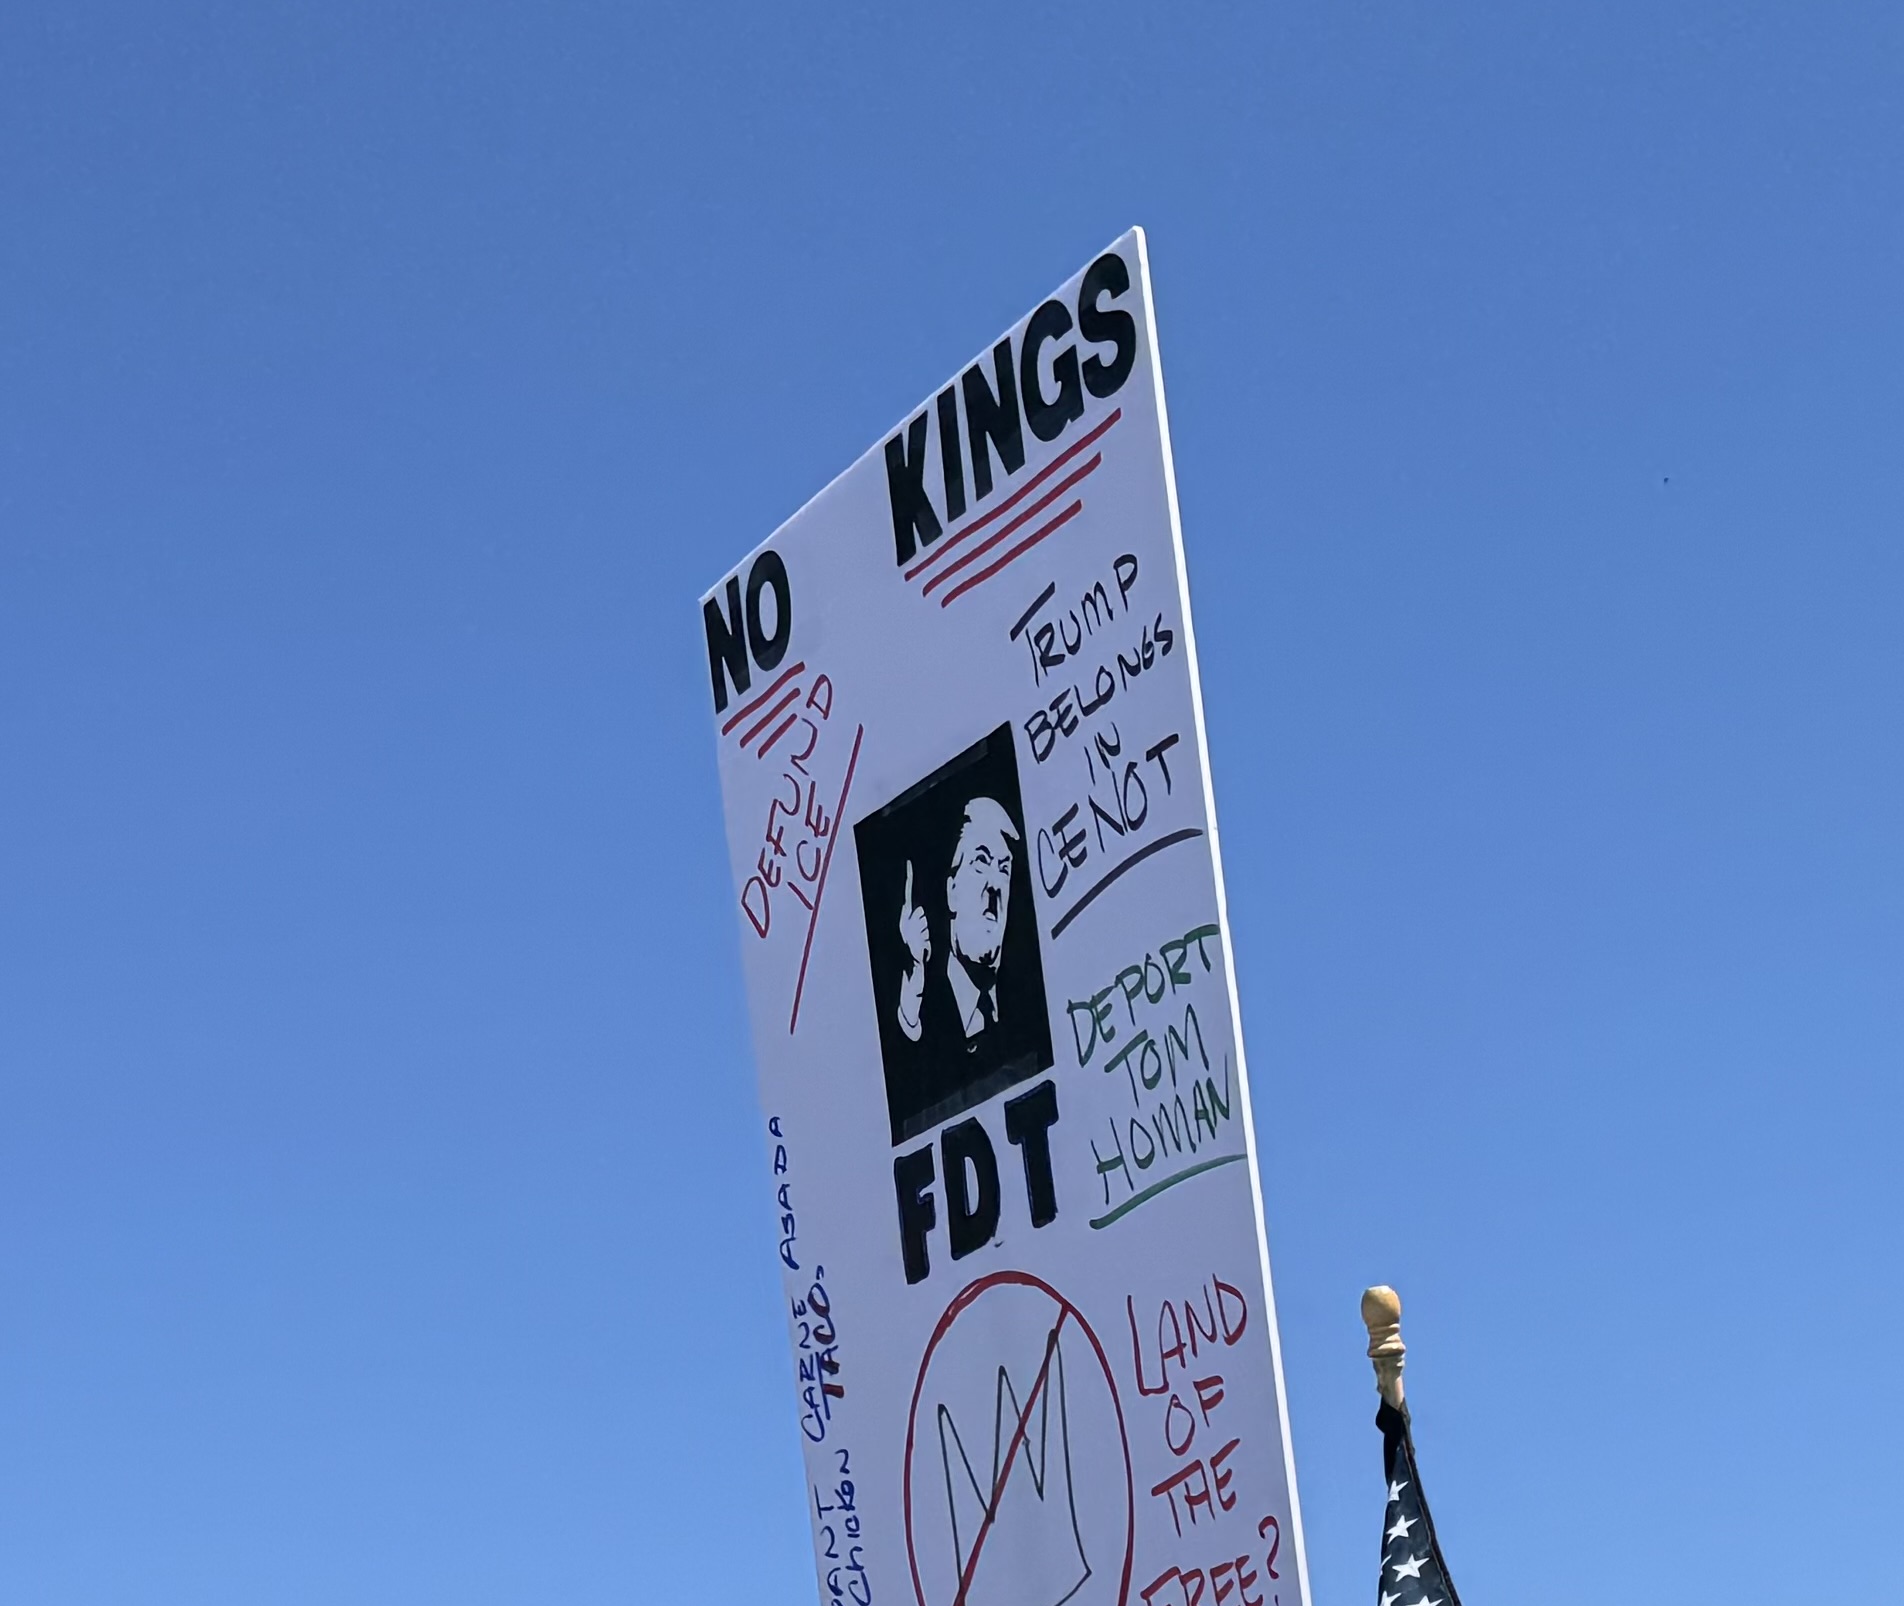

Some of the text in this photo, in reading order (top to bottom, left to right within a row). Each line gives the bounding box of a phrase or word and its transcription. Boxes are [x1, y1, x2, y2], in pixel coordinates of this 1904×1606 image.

[702, 253, 1137, 713] NO KINGS
[1010, 554, 1139, 687] TRUMP
[1024, 613, 1173, 765] BELONGS
[741, 674, 832, 938] DEFUND
[1084, 721, 1121, 786] IN
[788, 781, 830, 911] ICE
[1067, 924, 1219, 1068] DEPORT
[1104, 1003, 1209, 1108] TOM
[768, 1116, 800, 1270] ASADA
[895, 1079, 1058, 1285] FDT
[1091, 1052, 1230, 1205] HOMAN
[791, 1296, 825, 1441] CARNE
[1128, 1273, 1247, 1396] LAND
[1165, 1375, 1224, 1456] OF
[1151, 1438, 1240, 1538] THE
